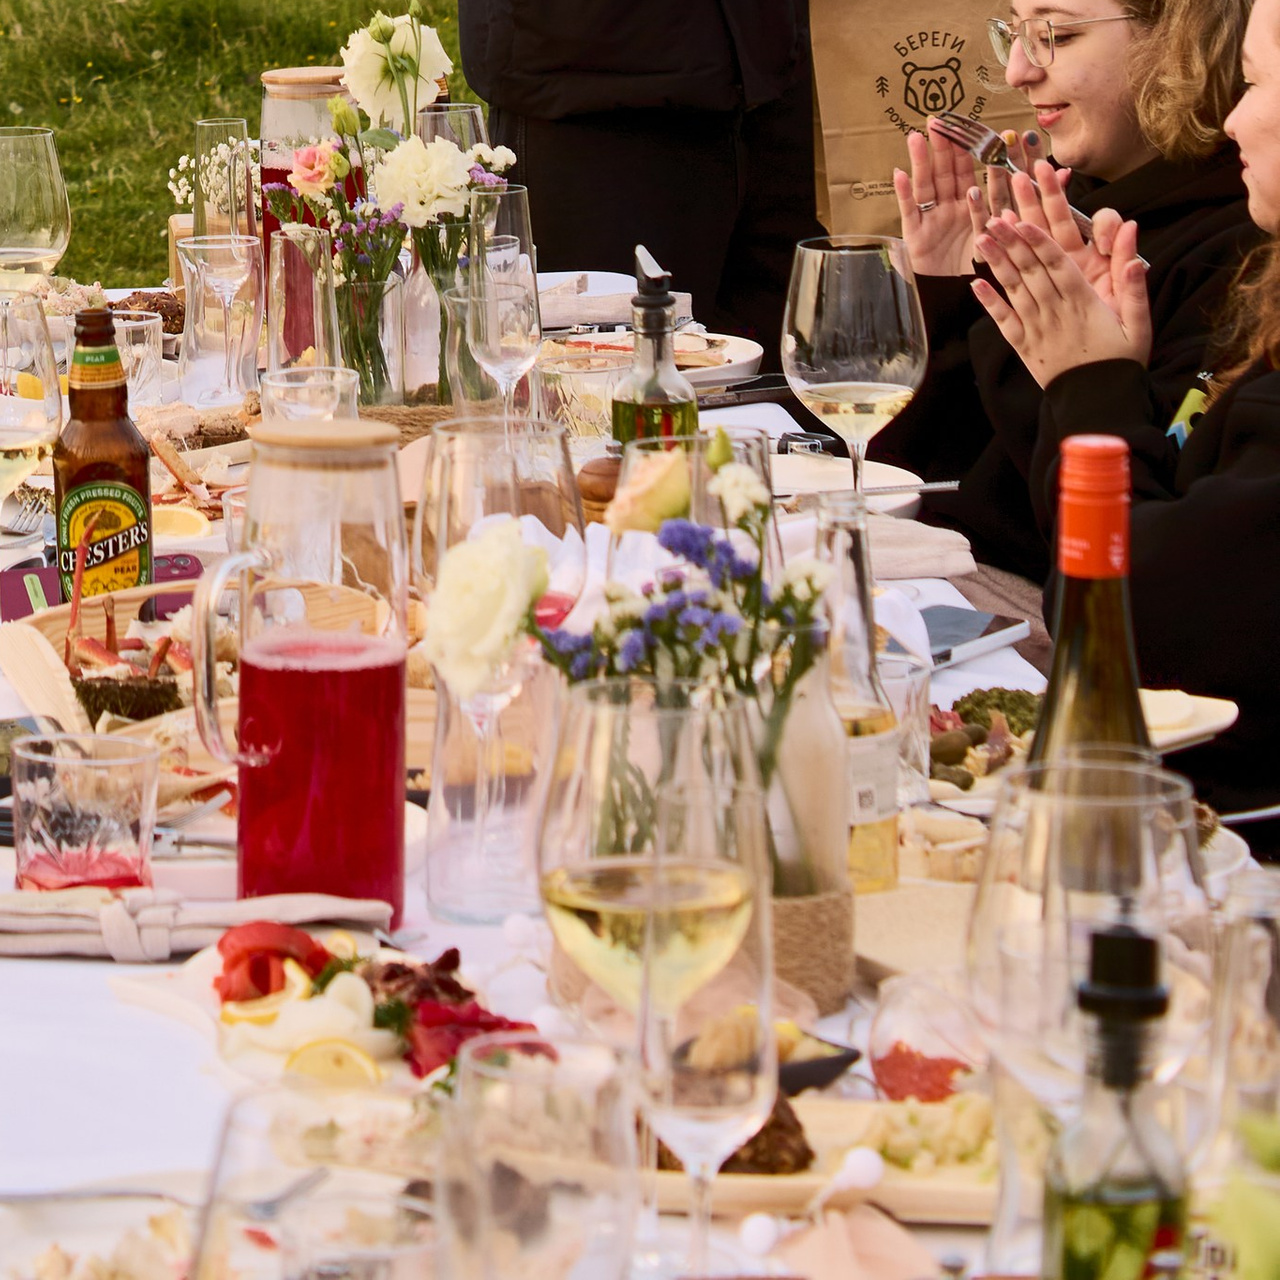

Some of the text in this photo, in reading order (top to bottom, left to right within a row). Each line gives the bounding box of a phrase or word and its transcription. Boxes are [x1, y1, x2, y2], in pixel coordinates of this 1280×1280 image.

[893, 30, 966, 57] БЕРЕГИ
[62, 494, 81, 519] FRESH
[81, 488, 122, 501] PRESSED
[114, 565, 137, 575] PEAR
